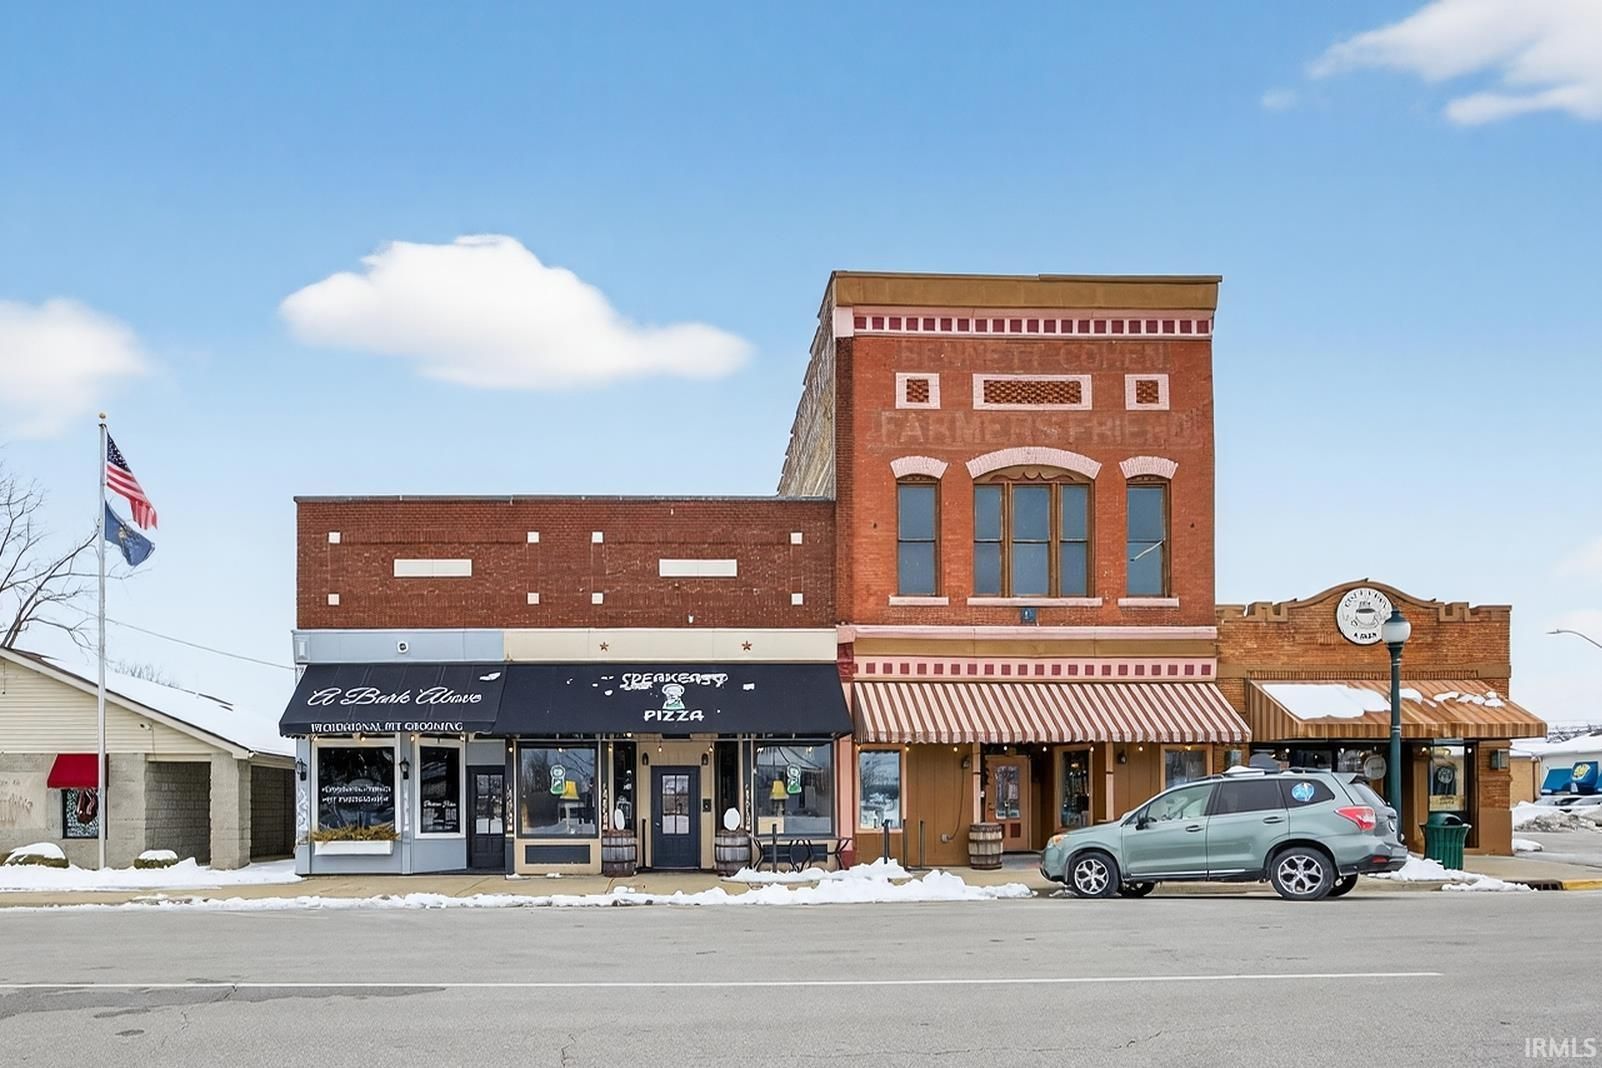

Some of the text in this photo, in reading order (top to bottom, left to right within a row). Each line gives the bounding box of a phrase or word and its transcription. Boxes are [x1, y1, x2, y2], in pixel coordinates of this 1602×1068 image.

[881, 410, 1061, 443] FARMERS
[307, 687, 342, 706] A
[643, 709, 705, 722] PIZZA
